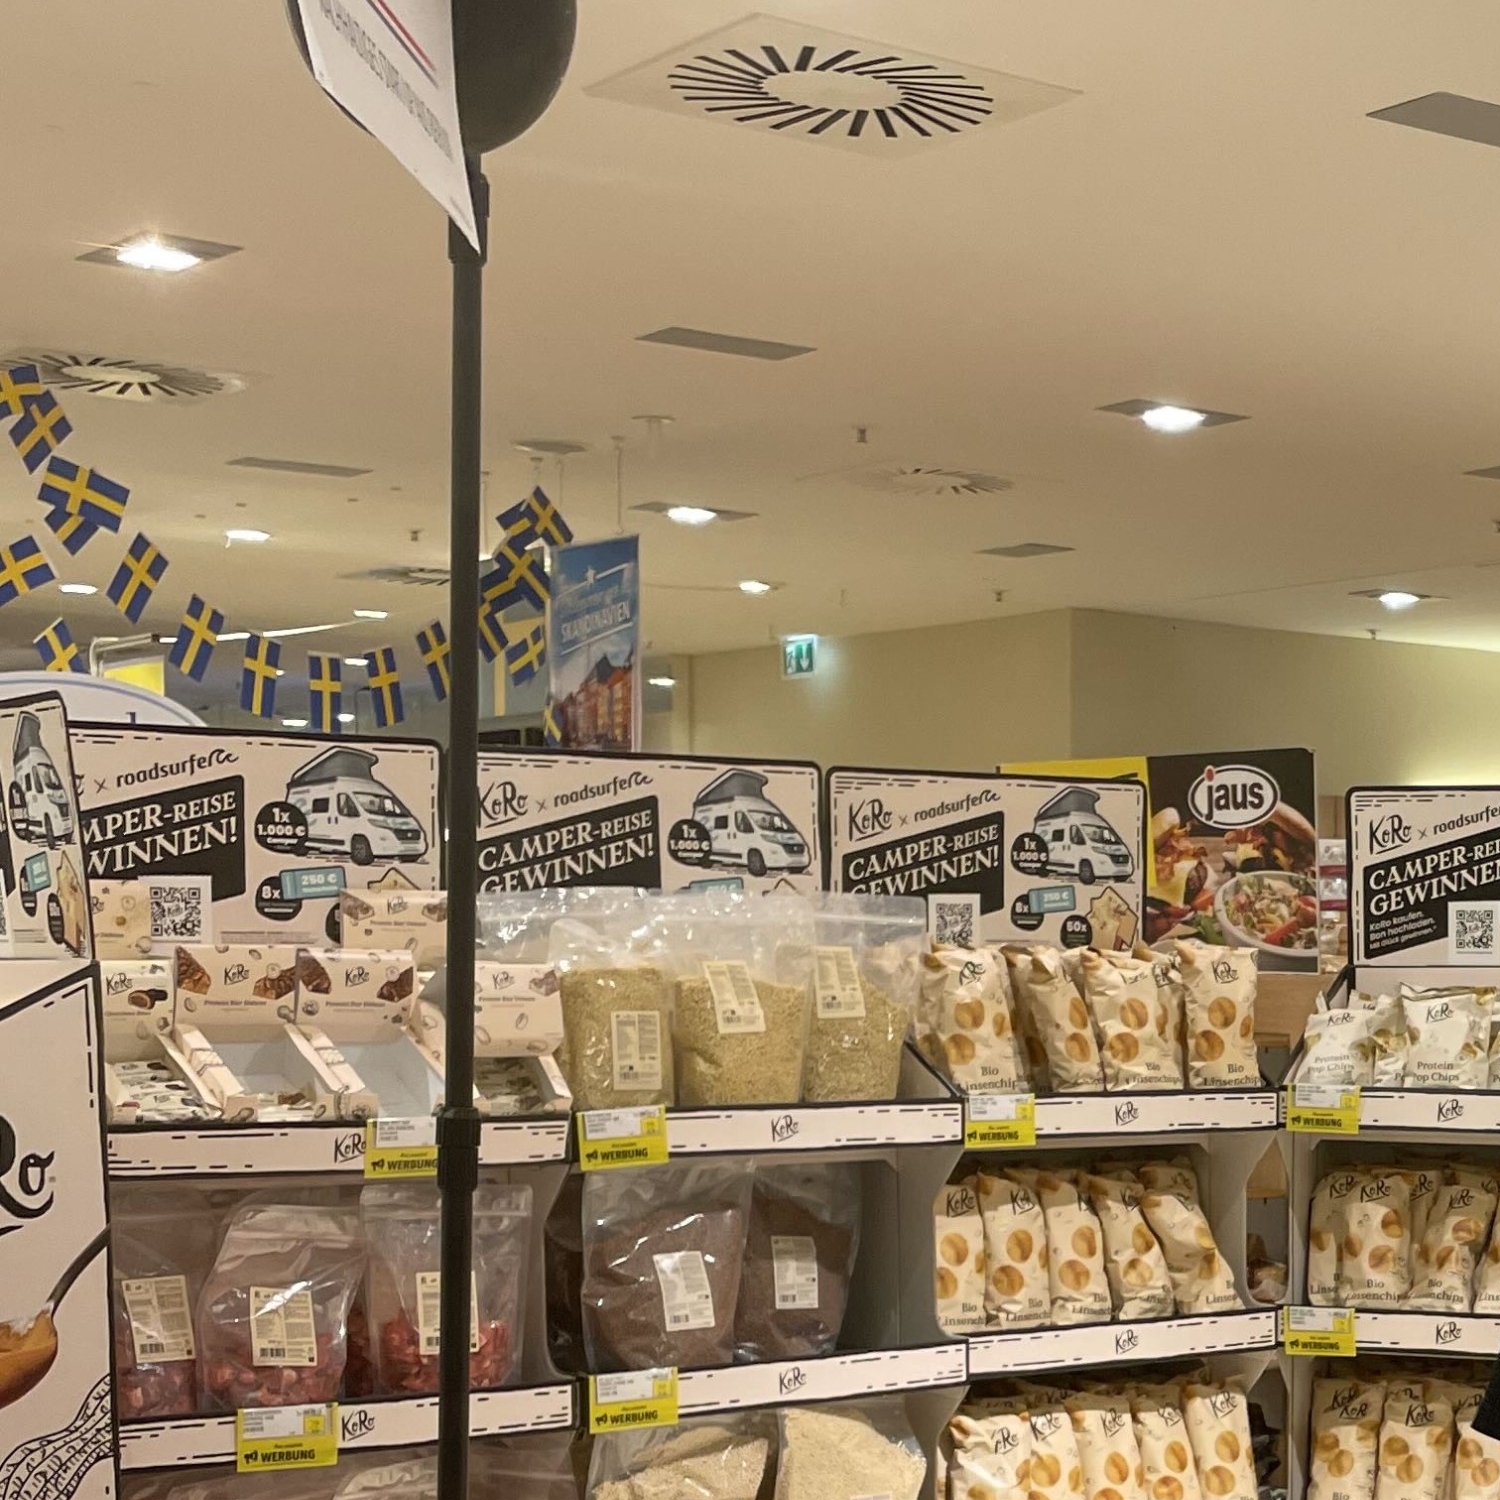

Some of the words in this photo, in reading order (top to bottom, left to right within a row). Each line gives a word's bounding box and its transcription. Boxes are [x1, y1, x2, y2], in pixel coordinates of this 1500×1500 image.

[117, 749, 239, 788] roadsurfer
[553, 771, 654, 808] roadsurfer
[1204, 765, 1265, 822] jaus
[272, 807, 290, 823] 1x
[848, 798, 894, 842] KoRo
[914, 788, 1002, 823] roadsurfer
[479, 809, 652, 872] CAMPER-REISE
[682, 825, 697, 839] 1x
[1369, 814, 1412, 855] KoRo
[848, 824, 999, 881] CAMPER-REISE
[1022, 837, 1037, 851] 1x
[479, 832, 655, 893] GEWINNEN!
[261, 885, 280, 899] 8x
[1015, 900, 1030, 914] 8x
[1066, 920, 1088, 934] 50x
[224, 963, 251, 985] KoRo
[345, 967, 370, 987] KoRo
[492, 970, 515, 990] KoRo
[1212, 959, 1239, 984] KoRo
[105, 974, 133, 995] KoRo
[1327, 1011, 1356, 1027] KoRo
[1425, 1001, 1455, 1023] KoRo
[1227, 1063, 1245, 1074] Bio
[1314, 1052, 1351, 1066] Protein
[1416, 1060, 1454, 1072] Protein
[981, 1066, 999, 1077] Bio
[1430, 1072, 1460, 1084] Chips
[1115, 1101, 1139, 1126] KoRo
[1437, 1099, 1464, 1123] KoRo
[771, 1116, 799, 1142] KoRo
[1302, 1117, 1342, 1129] WERBUNG
[600, 1147, 649, 1161] WERBUNG
[386, 1158, 438, 1173] WERBUNG
[1360, 1179, 1392, 1203] KoRo
[946, 1191, 975, 1217] KoRo
[1366, 1279, 1385, 1289] Bio
[1428, 1279, 1443, 1289] Bio
[962, 1302, 977, 1313] Bio
[1028, 1299, 1043, 1309] Bio
[1093, 1293, 1108, 1304] Bio
[1114, 1329, 1139, 1355] KoRo
[1435, 1321, 1462, 1345] KoRo
[778, 1366, 807, 1395] KoRo
[1210, 1391, 1238, 1420] KoRo
[1405, 1403, 1435, 1427] KoRo
[341, 1411, 376, 1441] KoRo
[609, 1410, 658, 1425] WERBUNG
[1030, 1412, 1062, 1442] KoRo
[1101, 1409, 1126, 1438] KoRo
[260, 1448, 316, 1463] WERBUNG
